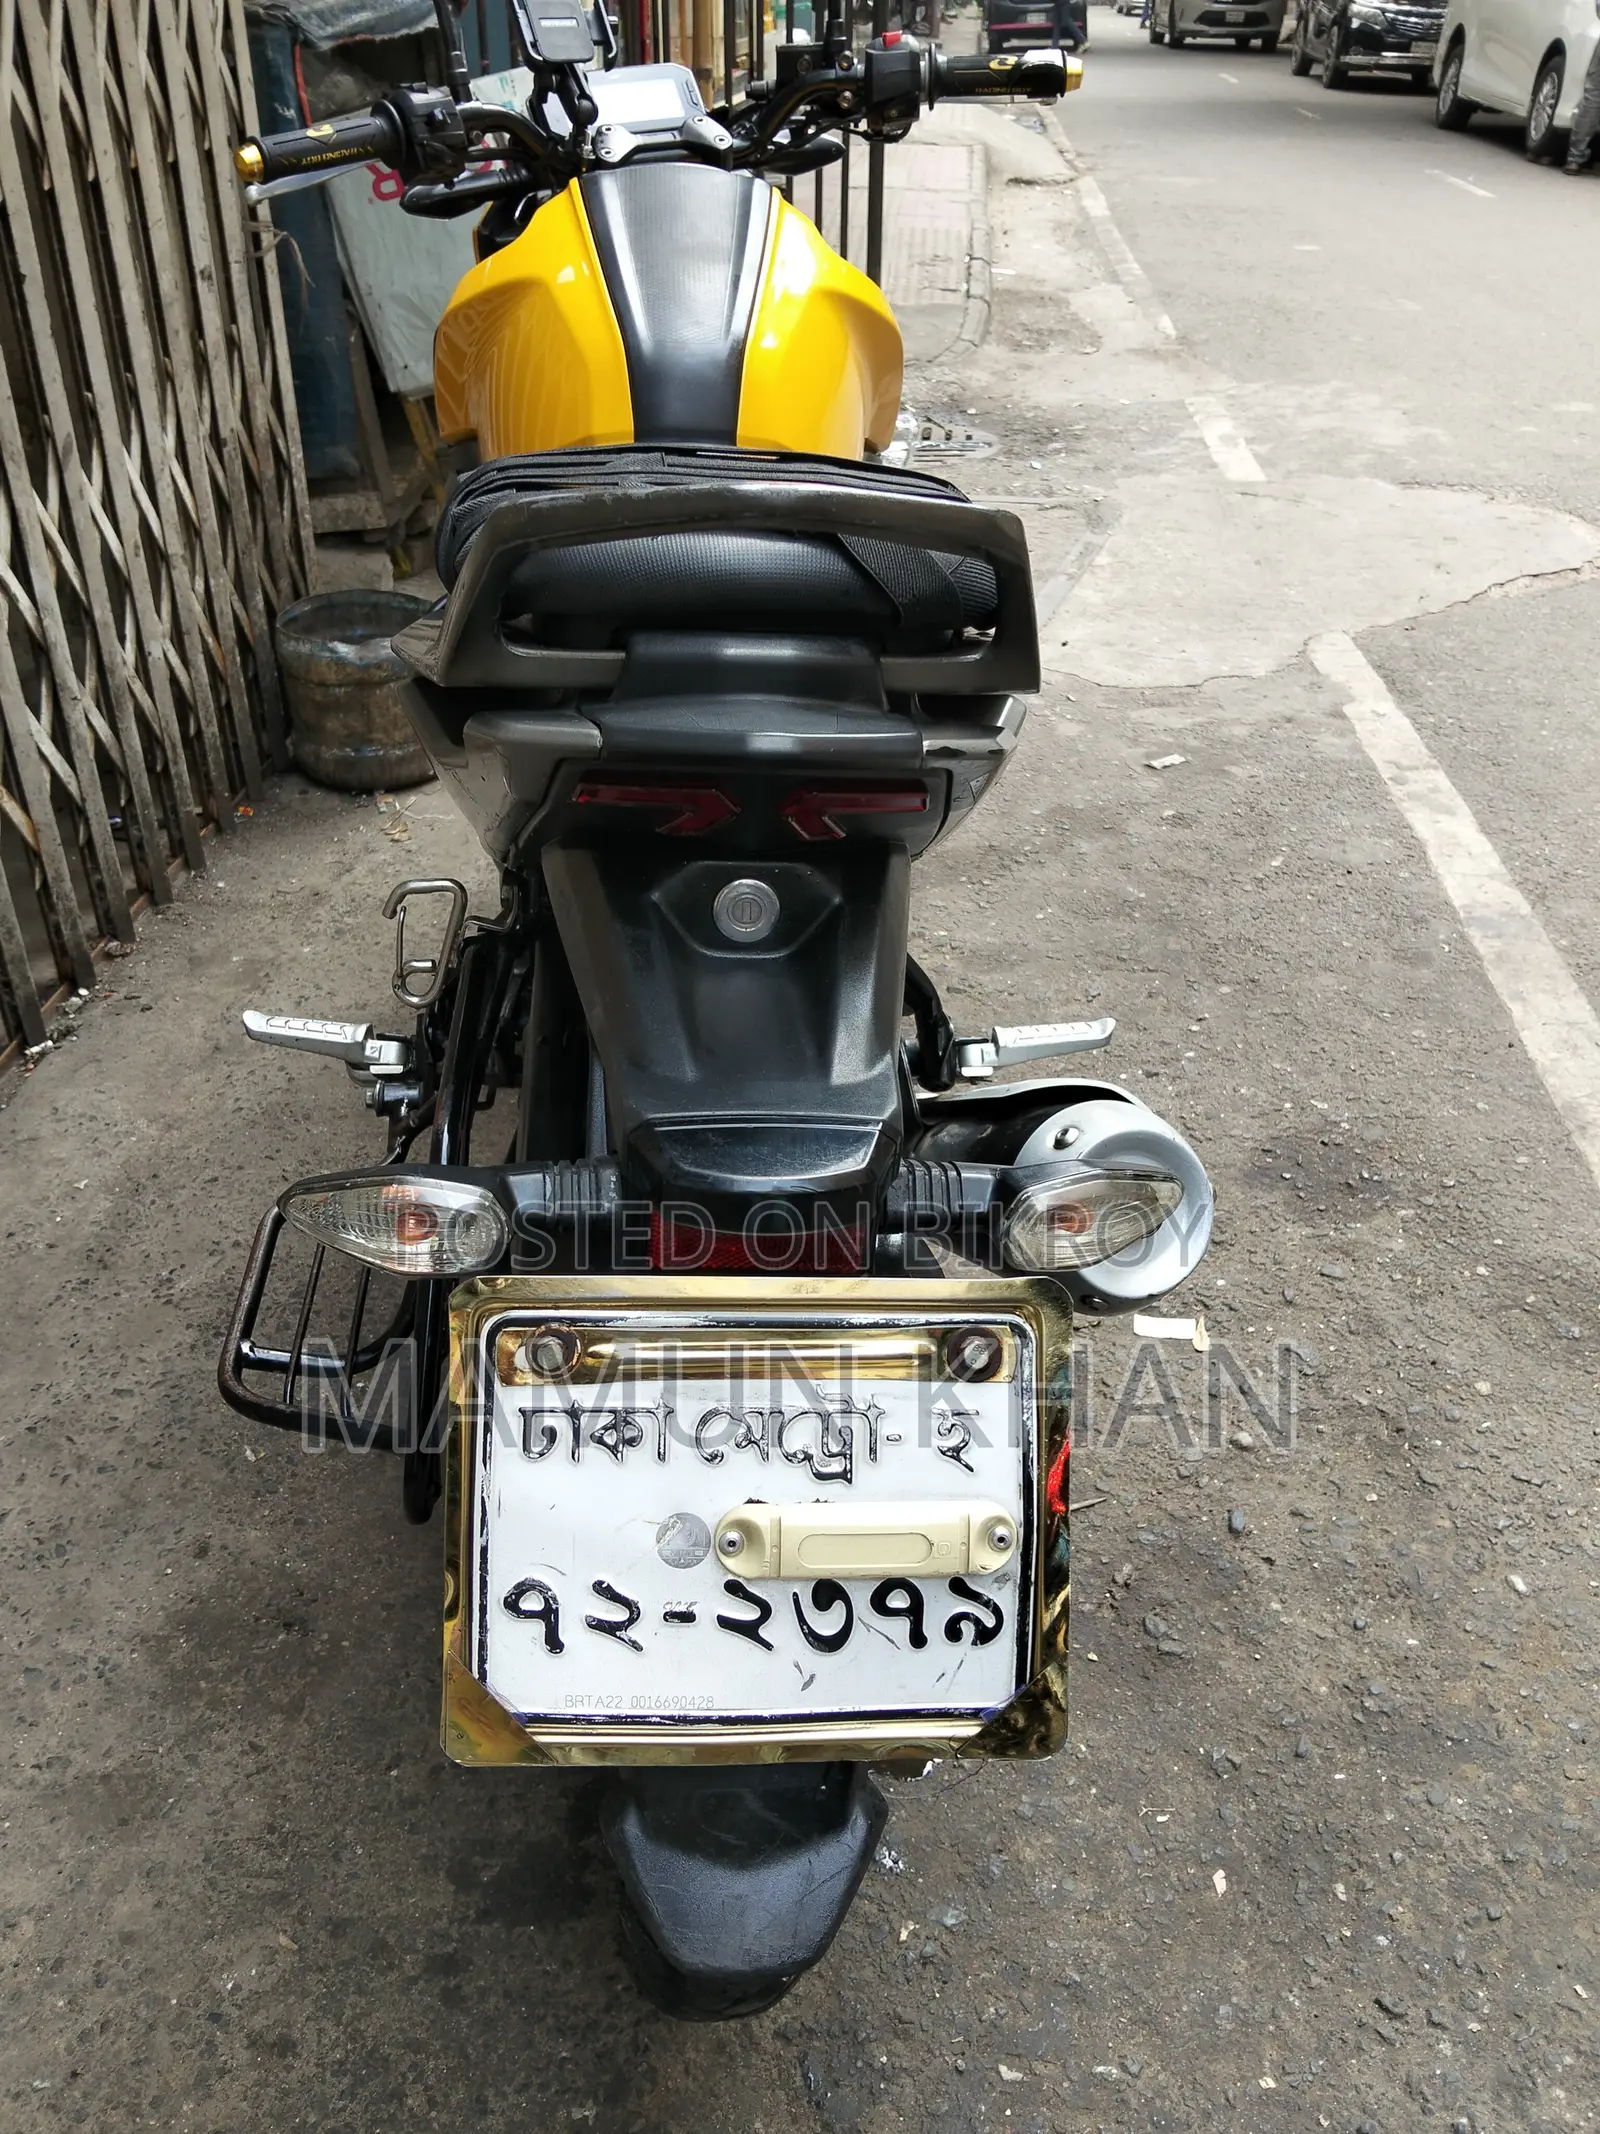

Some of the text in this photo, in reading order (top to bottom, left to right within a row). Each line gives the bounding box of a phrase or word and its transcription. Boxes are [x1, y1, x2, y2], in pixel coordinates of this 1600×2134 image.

[518, 1396, 674, 1464] ঢাকা
[564, 1694, 716, 1710] BRTA22 0016690428
